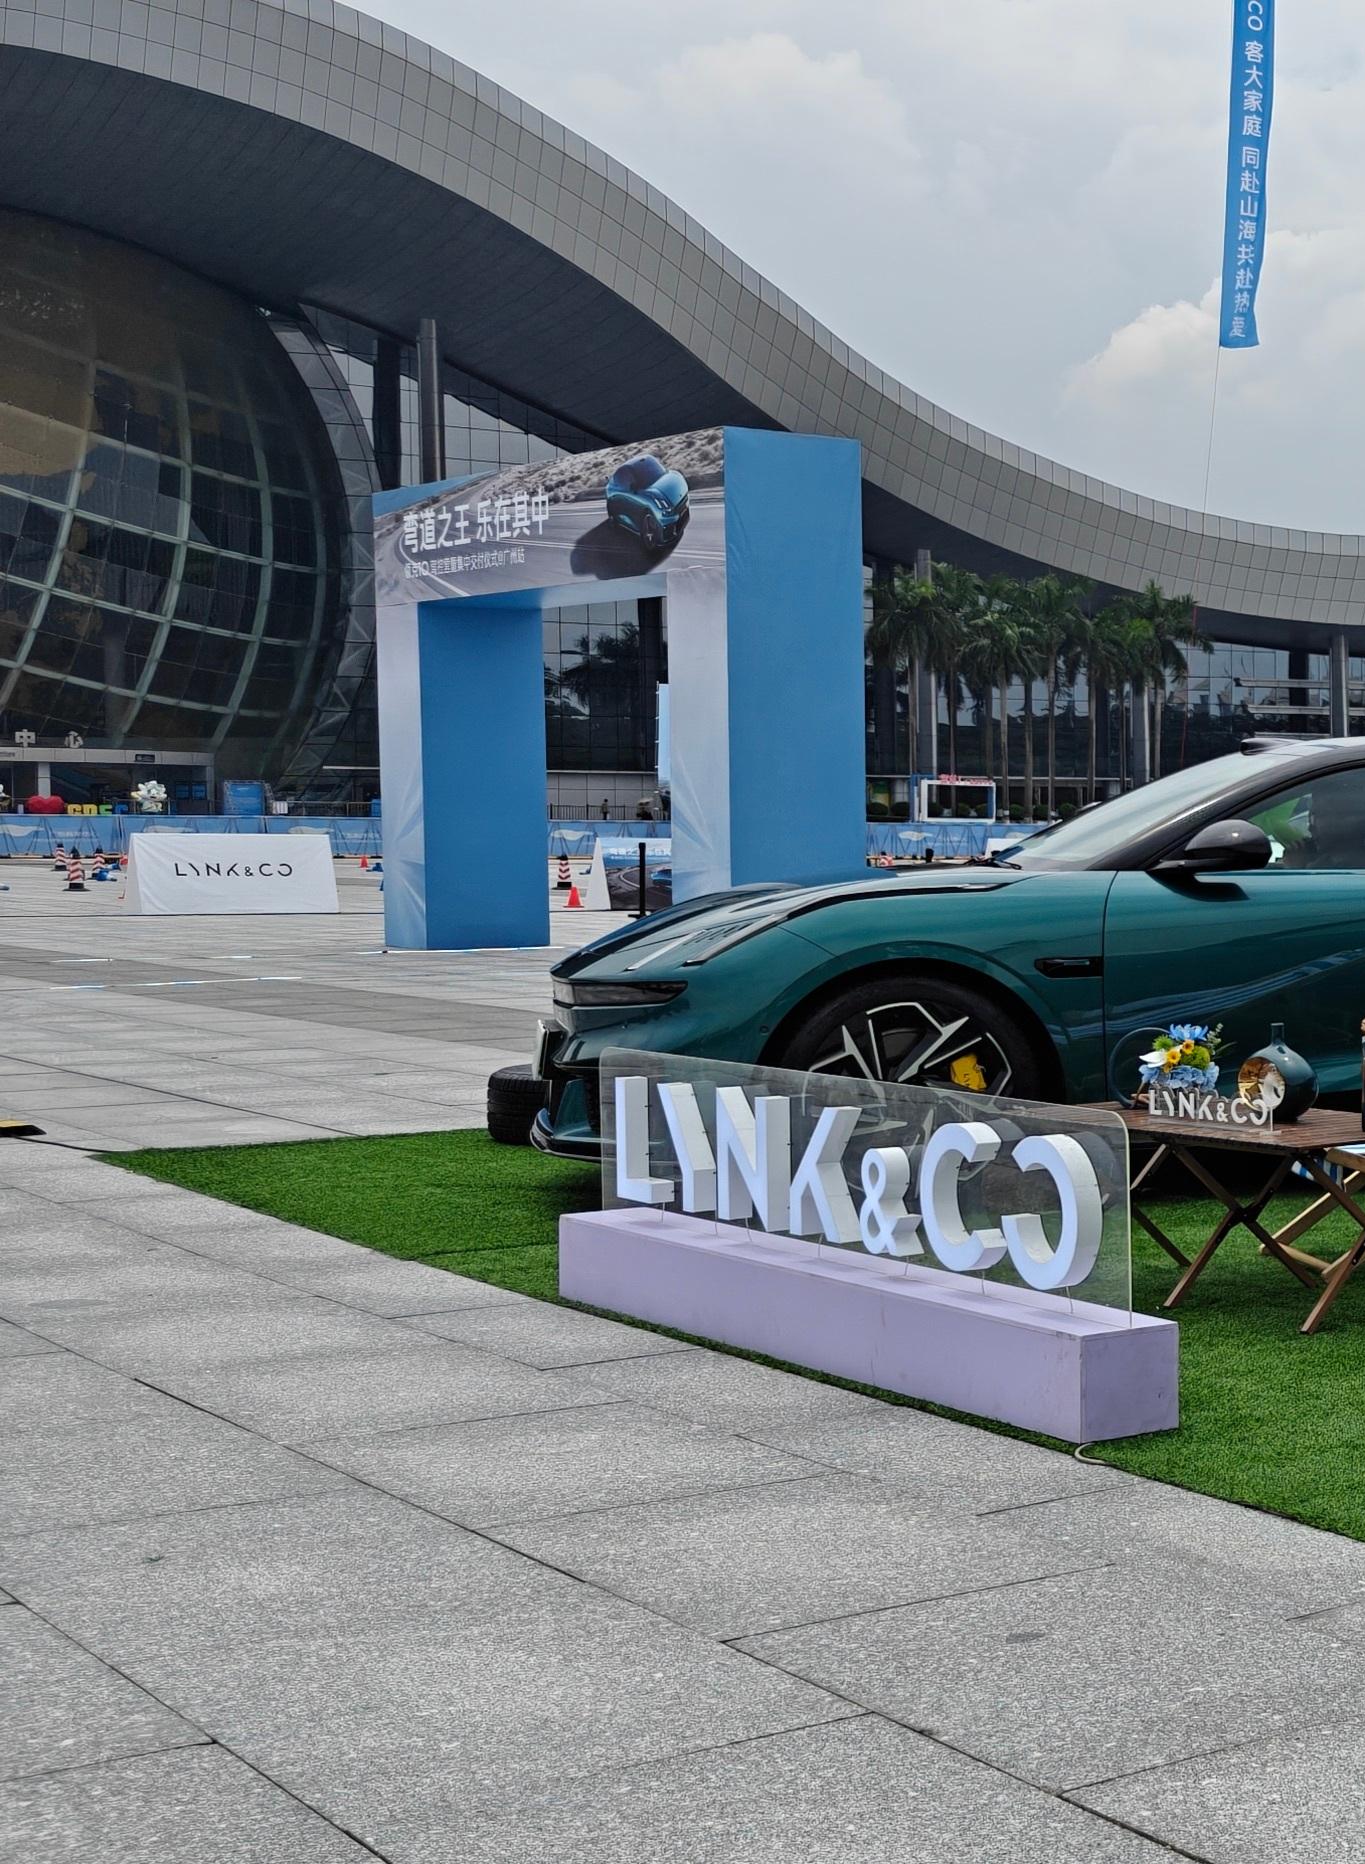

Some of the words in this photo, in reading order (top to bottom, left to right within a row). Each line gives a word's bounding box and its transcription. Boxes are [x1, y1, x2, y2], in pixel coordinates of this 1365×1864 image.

[1241, 40, 1263, 138] 客大家庭
[402, 504, 472, 554] 弯道之王
[477, 487, 550, 543] 乐在其中
[174, 862, 293, 877] LYNK&CO
[1149, 1089, 1269, 1126] LYNK&CO
[614, 1075, 1104, 1291] LYNK&CO
